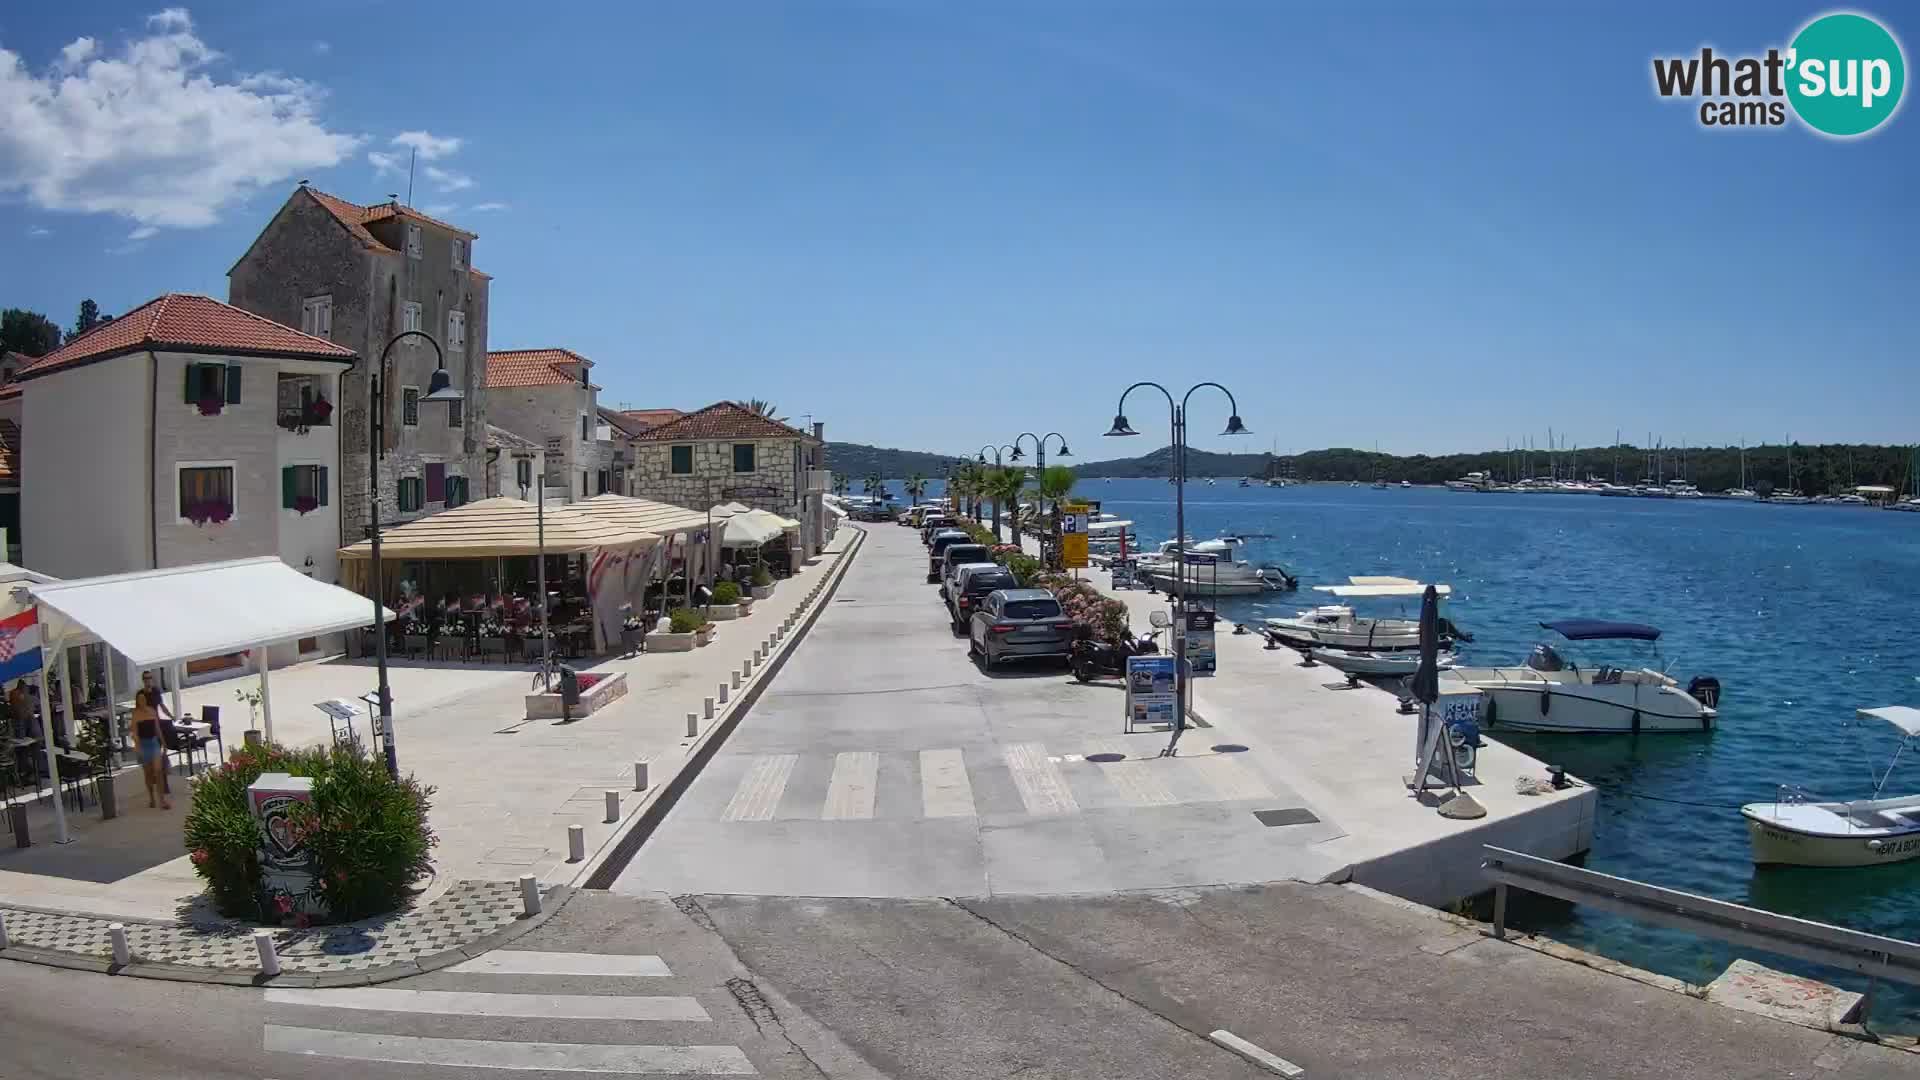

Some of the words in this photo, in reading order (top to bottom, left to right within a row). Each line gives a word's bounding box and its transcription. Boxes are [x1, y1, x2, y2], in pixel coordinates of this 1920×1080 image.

[1065, 515, 1075, 531] P
[1448, 703, 1479, 712] RENT
[1454, 711, 1478, 721] BOAT
